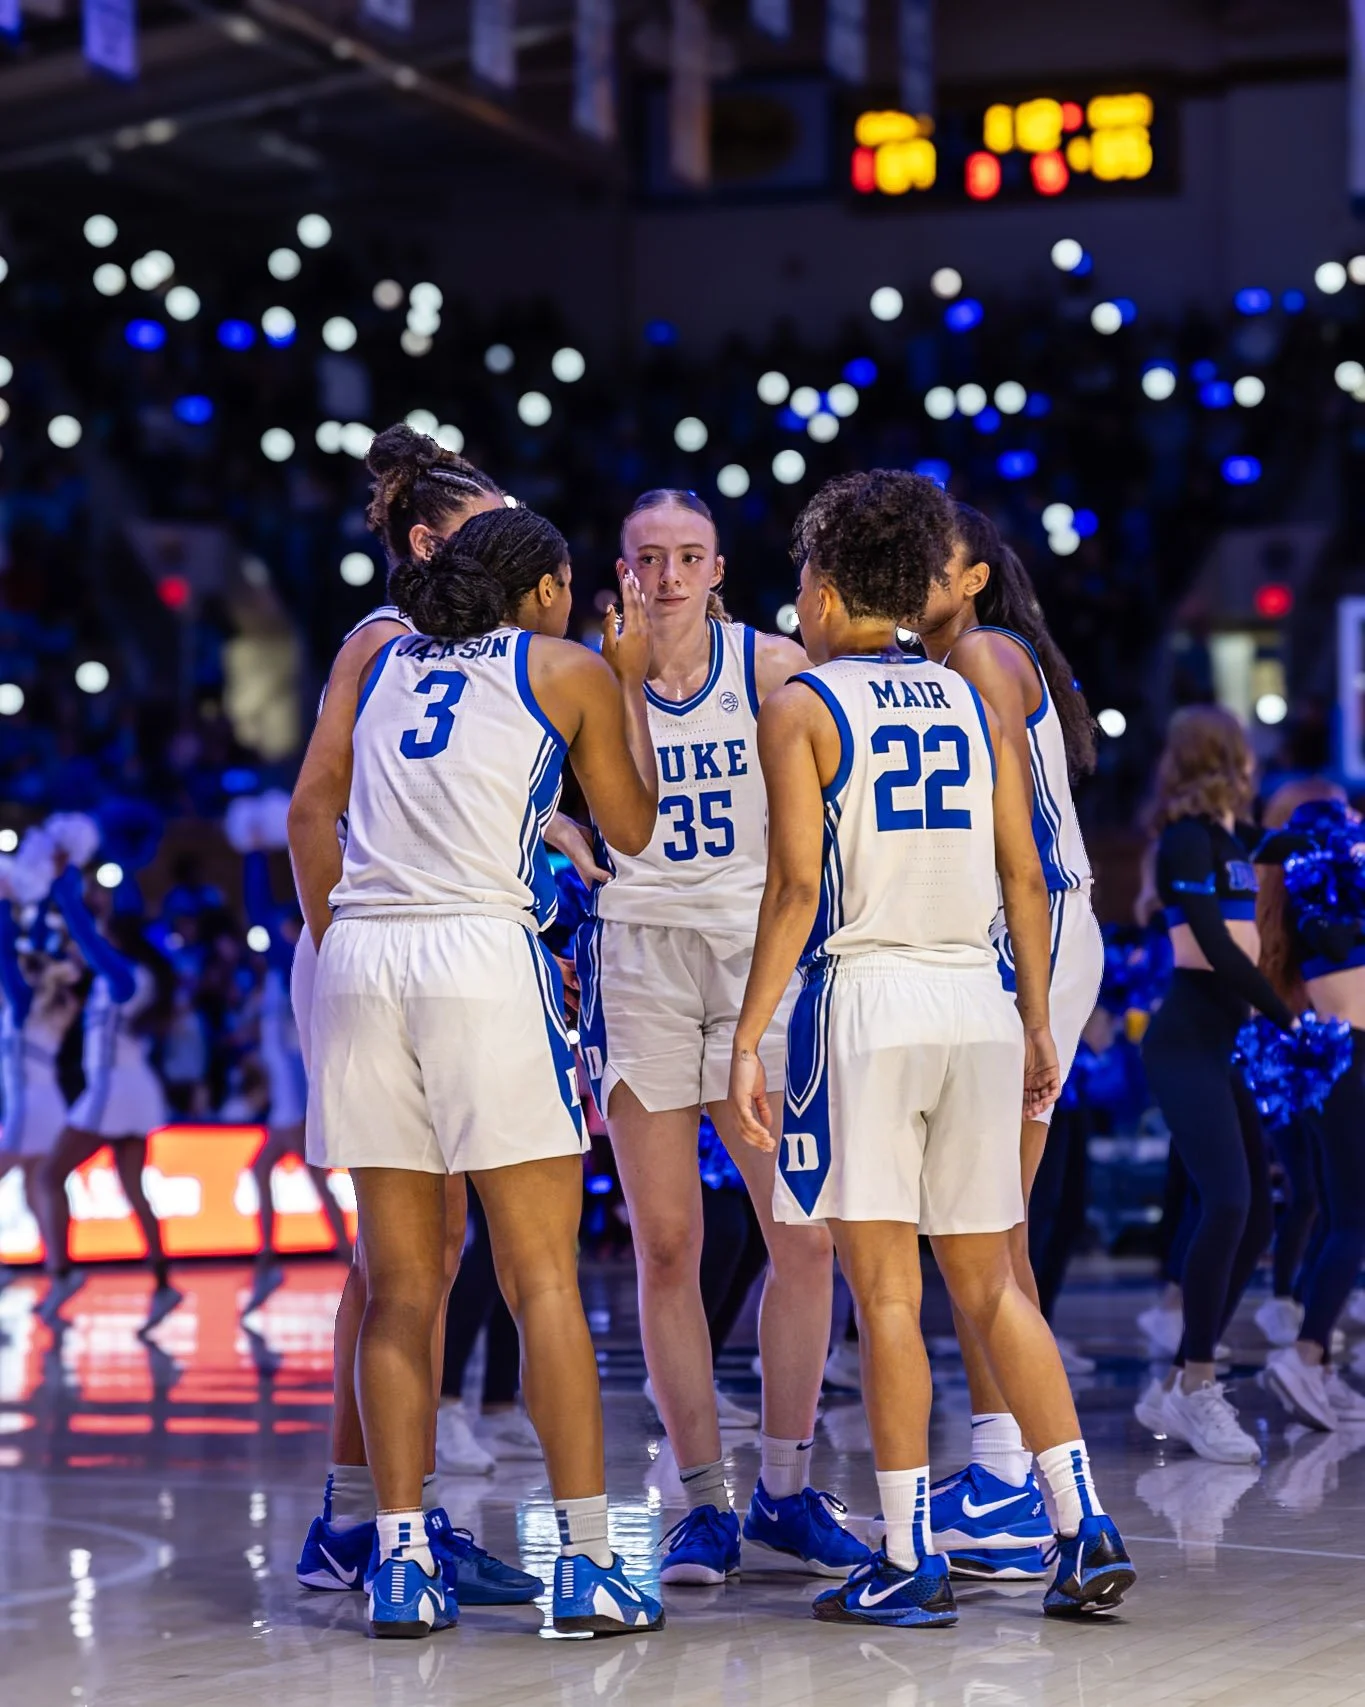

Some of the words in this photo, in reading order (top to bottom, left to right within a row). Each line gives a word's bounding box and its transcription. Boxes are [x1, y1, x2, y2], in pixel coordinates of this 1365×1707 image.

[399, 670, 468, 760] 3
[868, 680, 951, 709] MAIR
[656, 739, 748, 783] UKE
[870, 724, 972, 832] 22
[658, 789, 735, 862] 35
[783, 1132, 820, 1172] D
